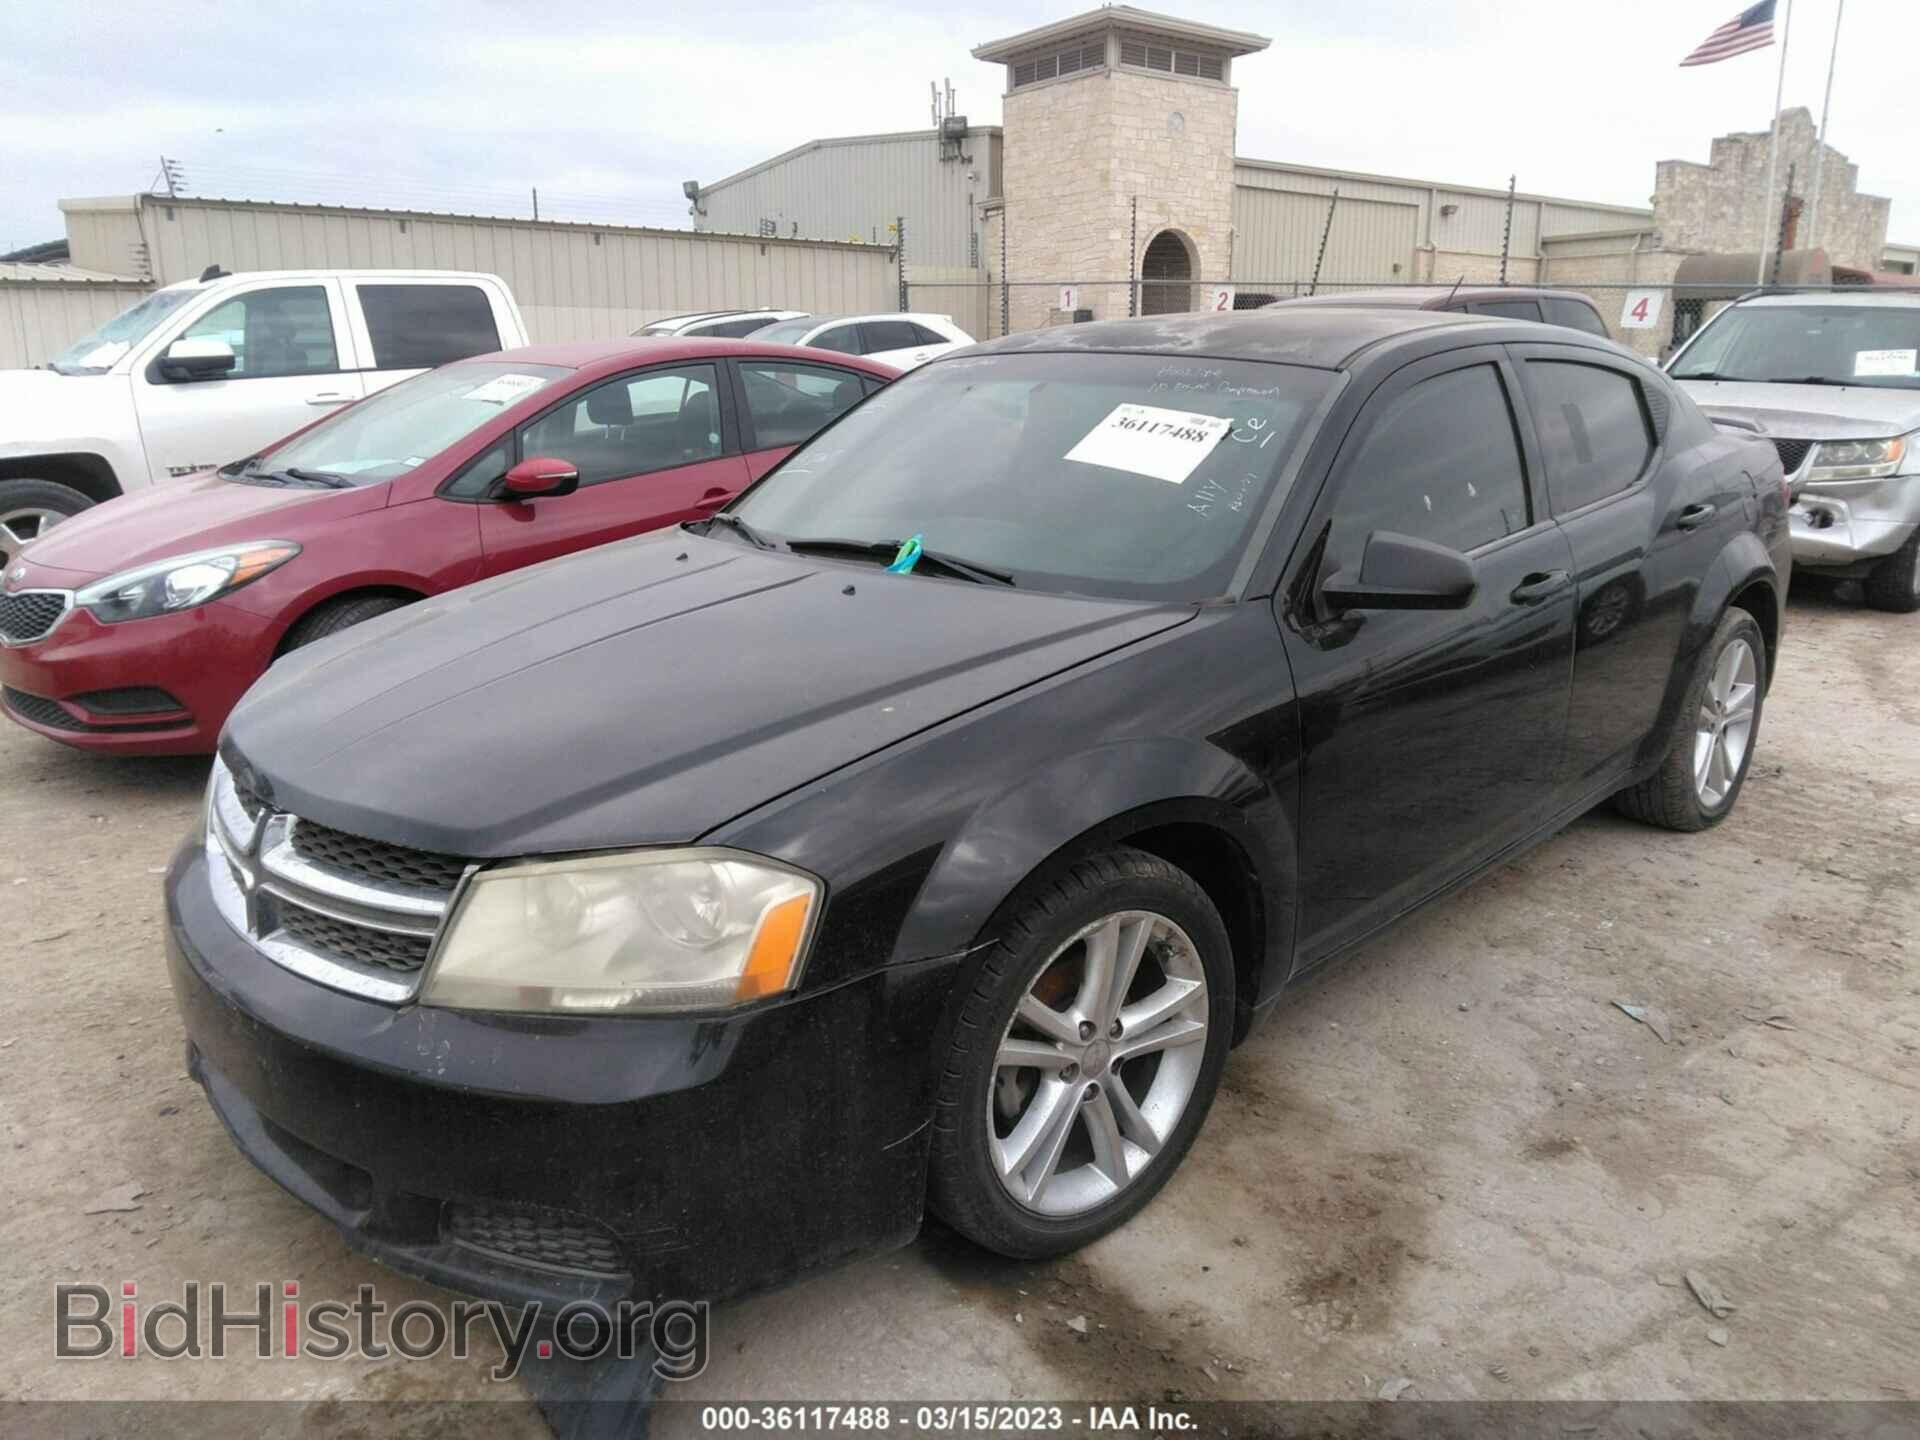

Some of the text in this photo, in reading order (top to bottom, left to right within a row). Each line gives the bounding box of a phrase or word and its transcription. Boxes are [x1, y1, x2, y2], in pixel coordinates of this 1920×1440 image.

[1065, 289, 1071, 307] 1
[1216, 291, 1229, 311] 2
[1631, 297, 1649, 322] 4
[1111, 416, 1209, 443] 36117488
